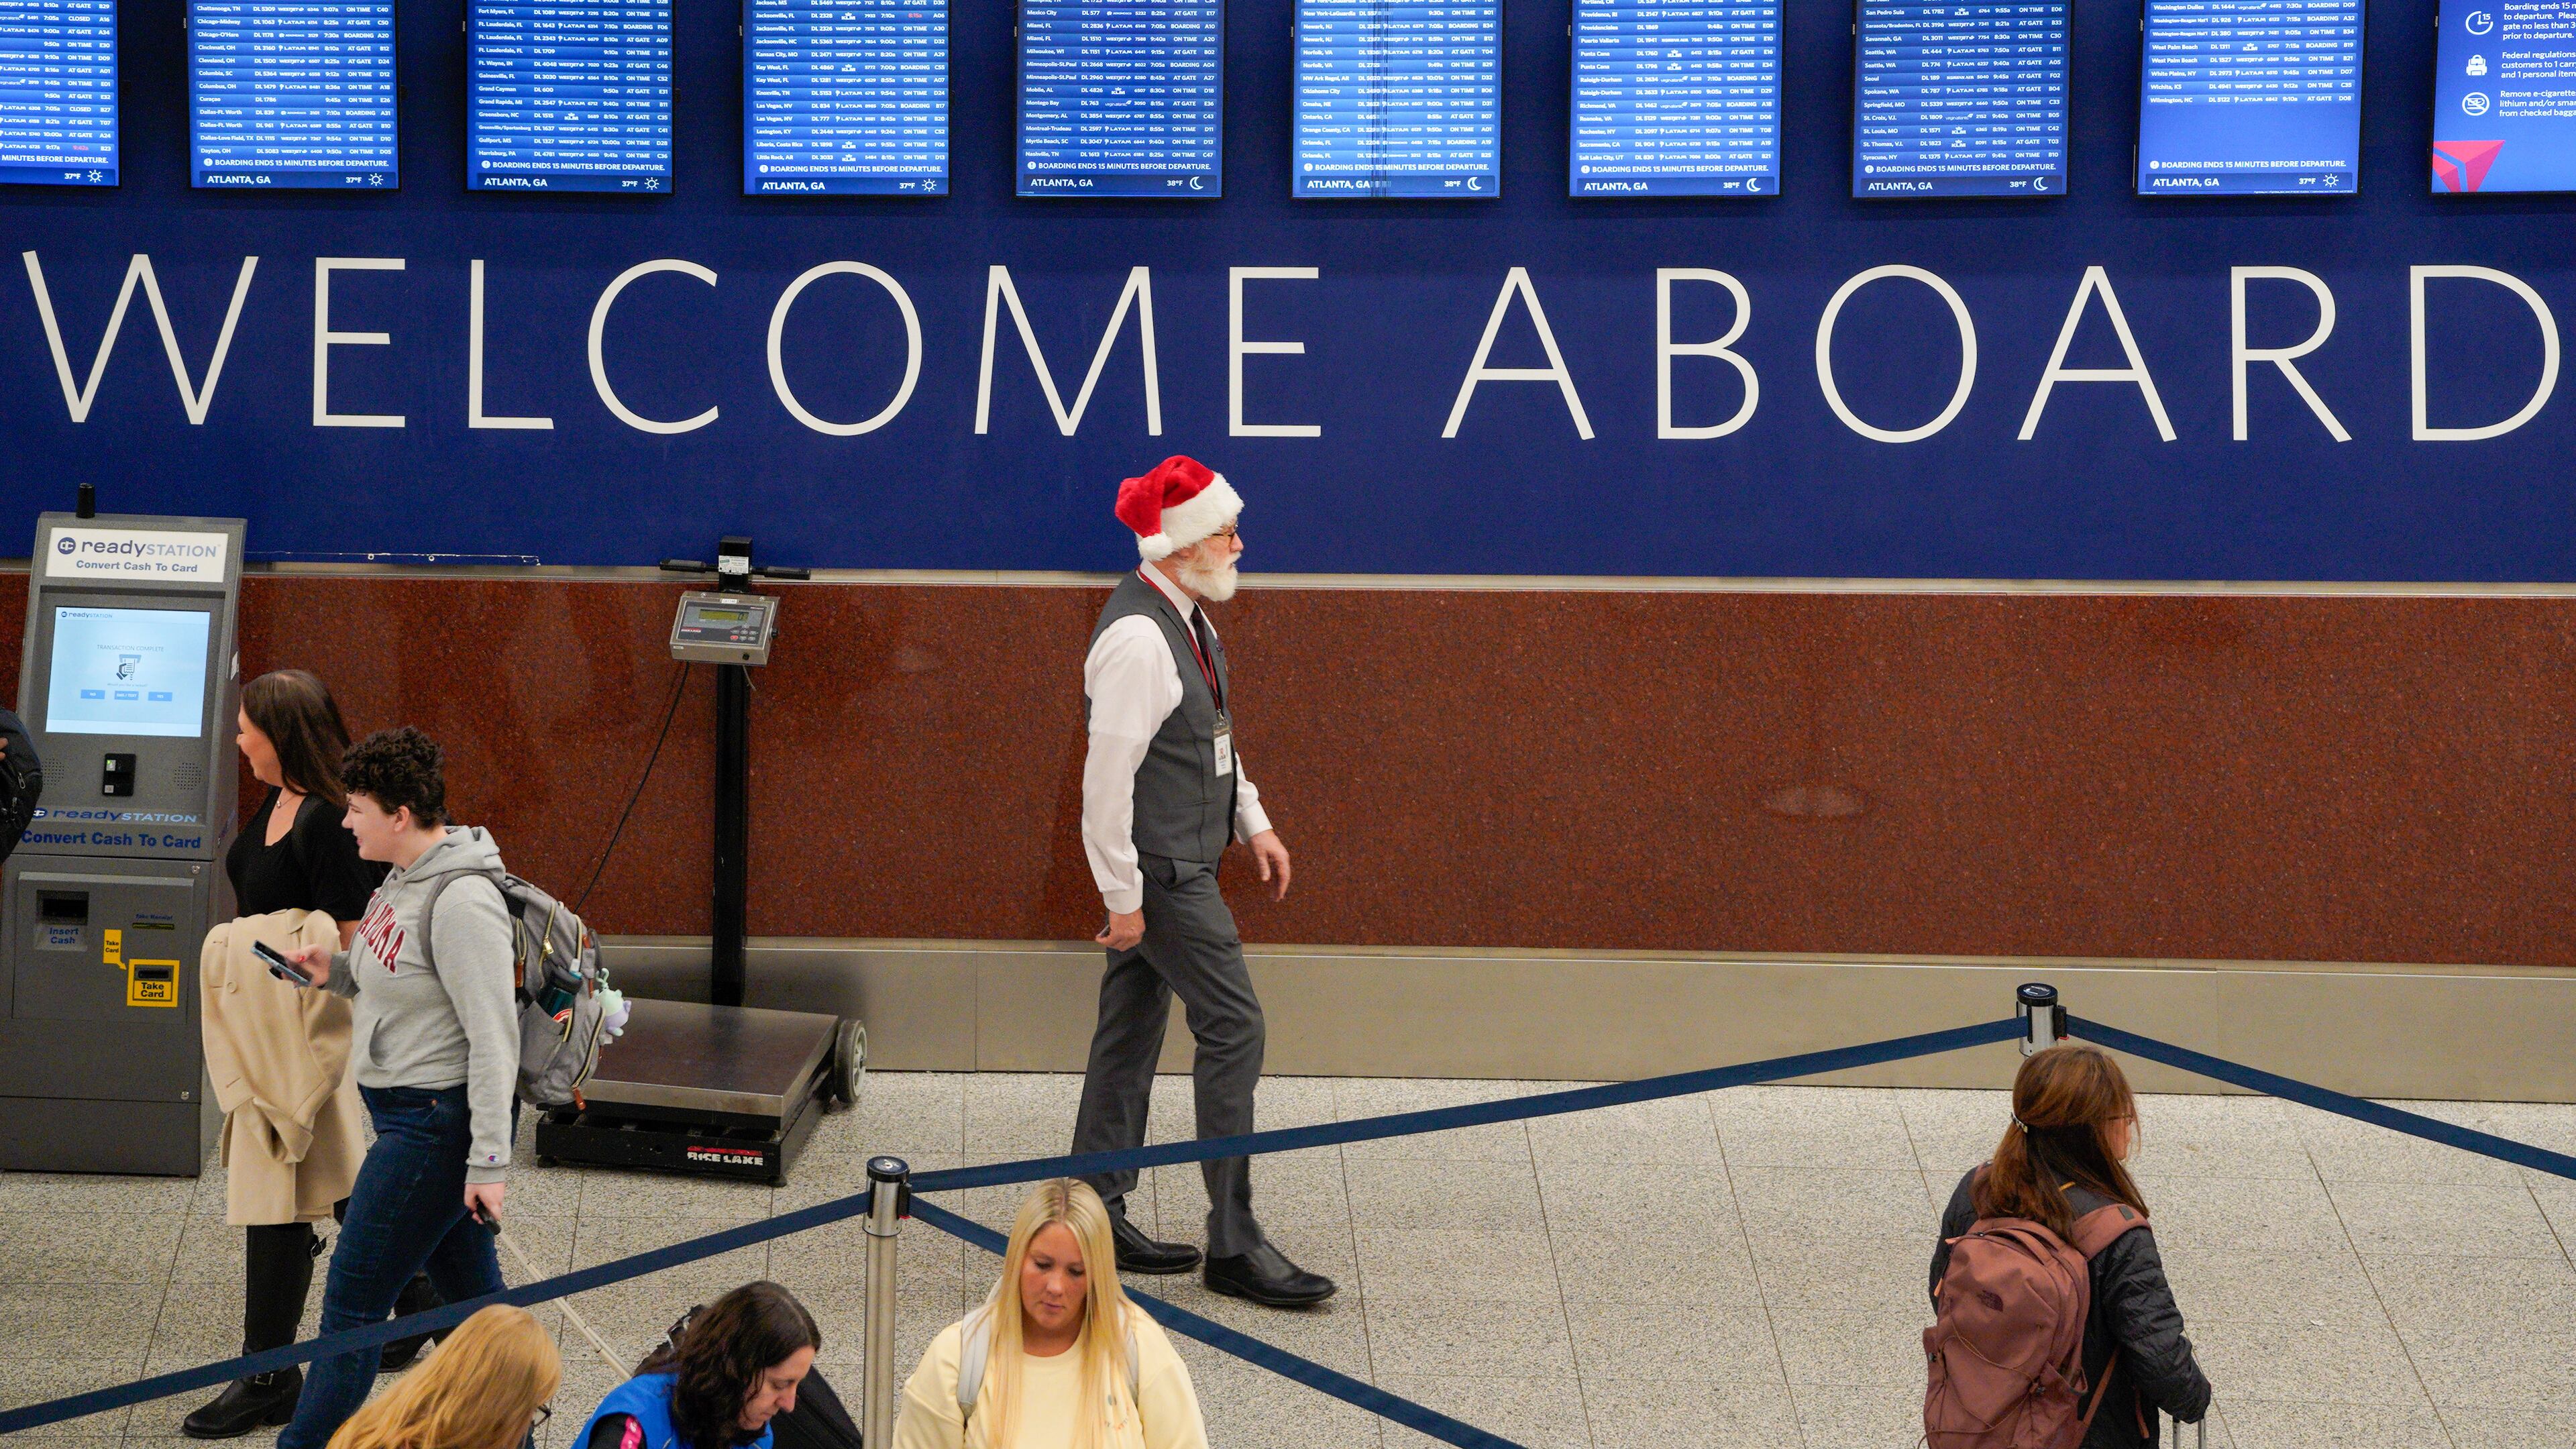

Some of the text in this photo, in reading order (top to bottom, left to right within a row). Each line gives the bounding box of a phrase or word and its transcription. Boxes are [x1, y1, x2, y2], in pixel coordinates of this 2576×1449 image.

[2504, 3, 2539, 11] Boarding
[2503, 23, 2520, 31] gate
[2502, 32, 2522, 40] prior
[2533, 32, 2574, 40] departure.
[2532, 51, 2576, 59] regulations
[2522, 70, 2557, 78] personal
[207, 175, 254, 184] ATLANTA,
[484, 178, 547, 186] ATLANTA, GA
[1030, 178, 1093, 187] ATLANTA, GA
[2153, 178, 2219, 186] ATLANTA, GA
[762, 182, 808, 191] ATLANTA,
[1307, 180, 1370, 189] ATLANTA, GA
[1584, 182, 1648, 191] ATLANTA, GA
[1868, 182, 1916, 191] ATLANTA,
[22, 251, 2562, 443] WELCOME ABOARD
[81, 540, 217, 557] readySTATION
[76, 560, 197, 572] Convert Cash To Card
[53, 810, 197, 822] readySTATION
[21, 830, 201, 848] Convert Cash To Card
[49, 927, 79, 935] Insert
[50, 936, 75, 945] Cash
[141, 982, 164, 990] Take
[140, 989, 164, 998] Card
[687, 1151, 763, 1166] RICE LAKE
